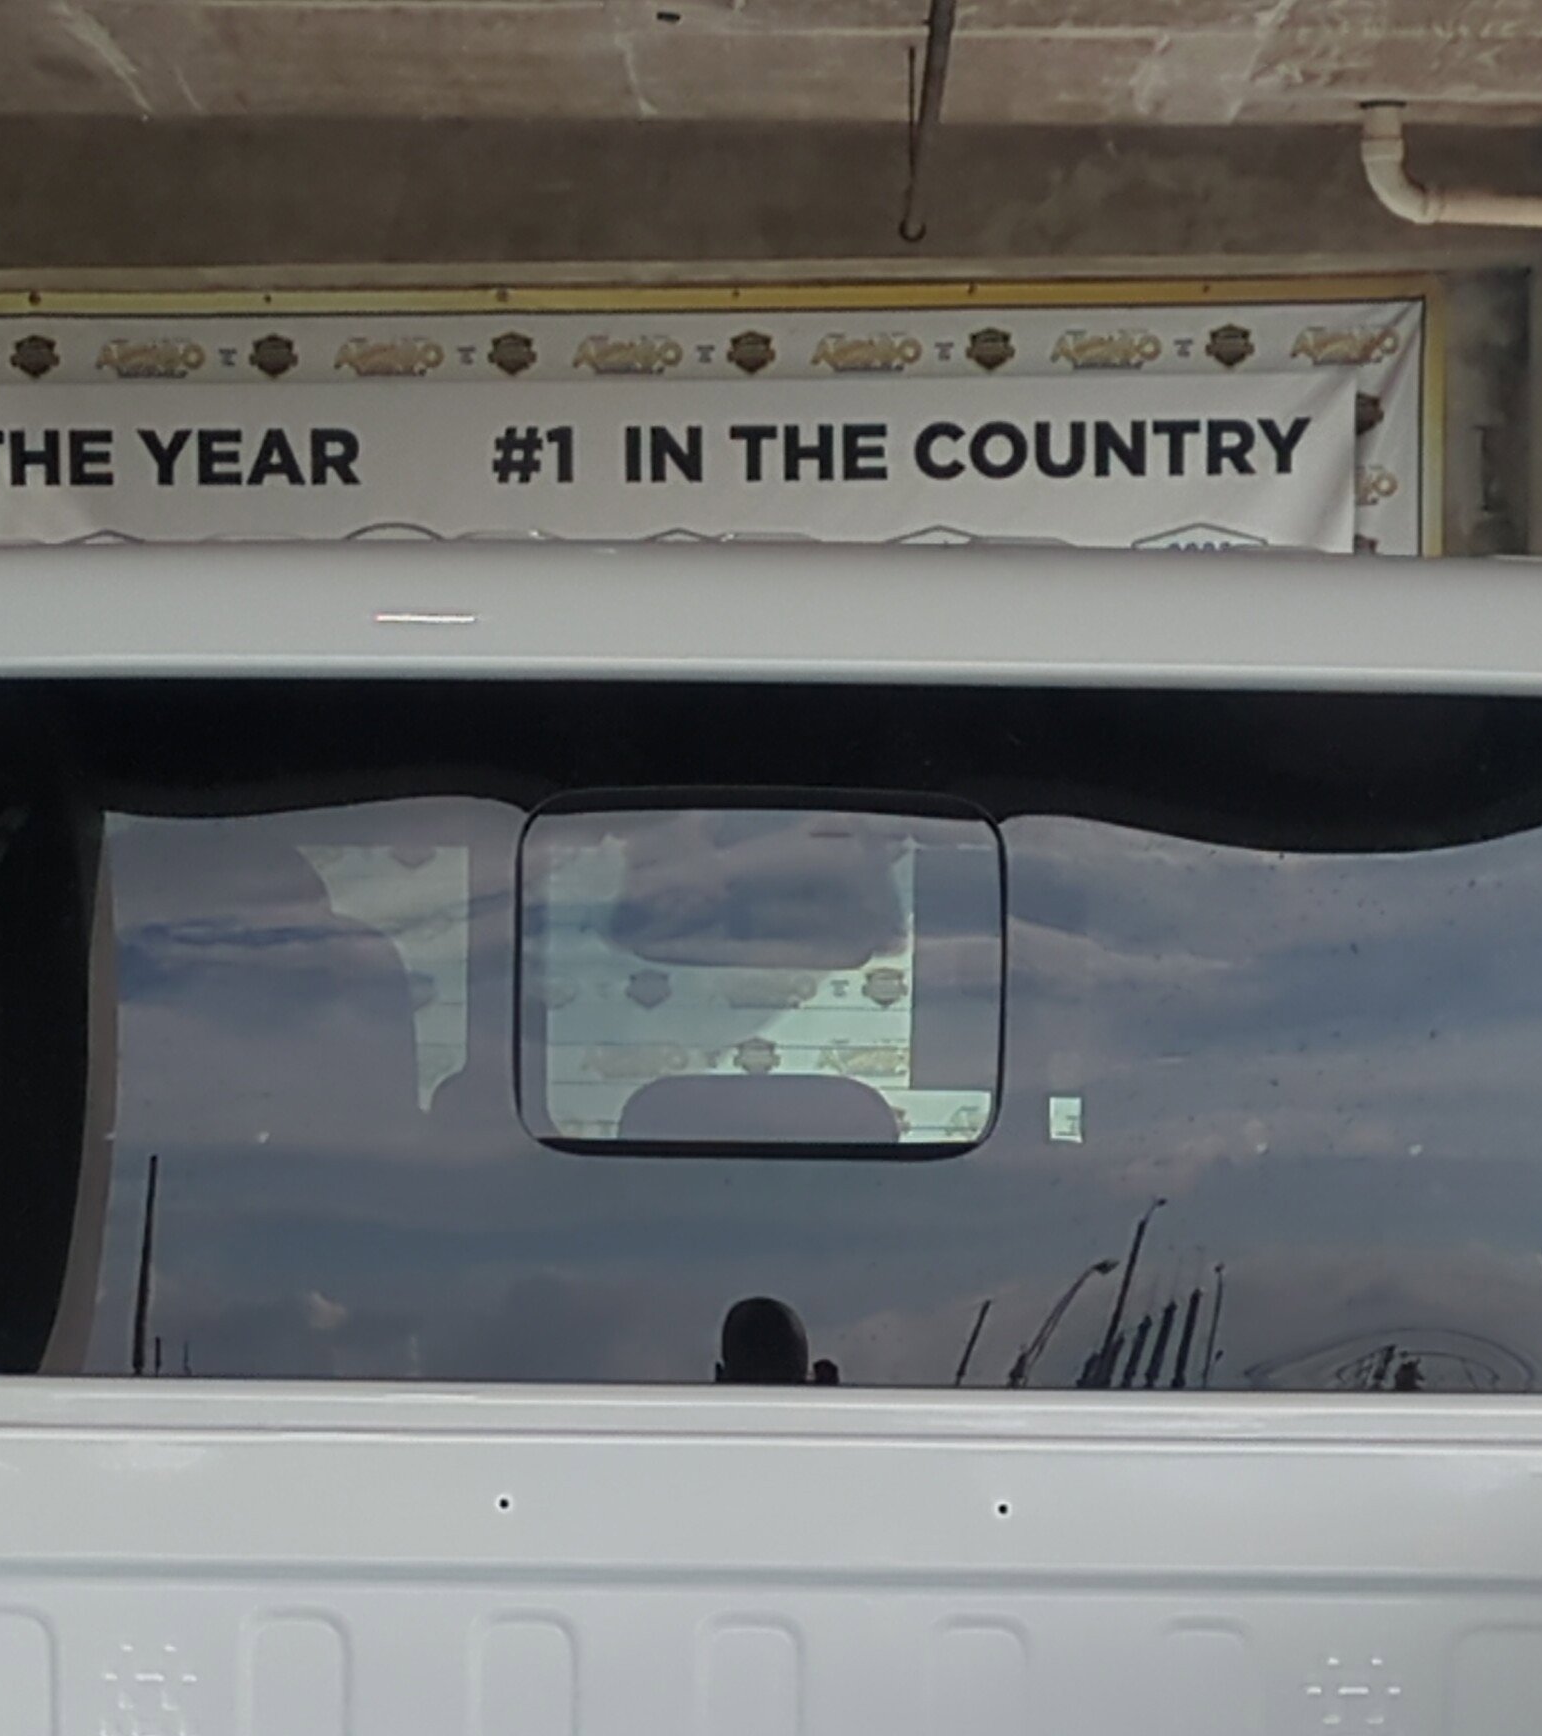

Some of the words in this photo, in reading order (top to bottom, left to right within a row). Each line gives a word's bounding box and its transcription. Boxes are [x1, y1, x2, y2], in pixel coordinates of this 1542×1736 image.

[137, 428, 361, 486] YEAR
[491, 426, 575, 484] #1
[624, 425, 704, 483] IN
[729, 423, 888, 482] THE
[913, 416, 1312, 480] COUNTRY
